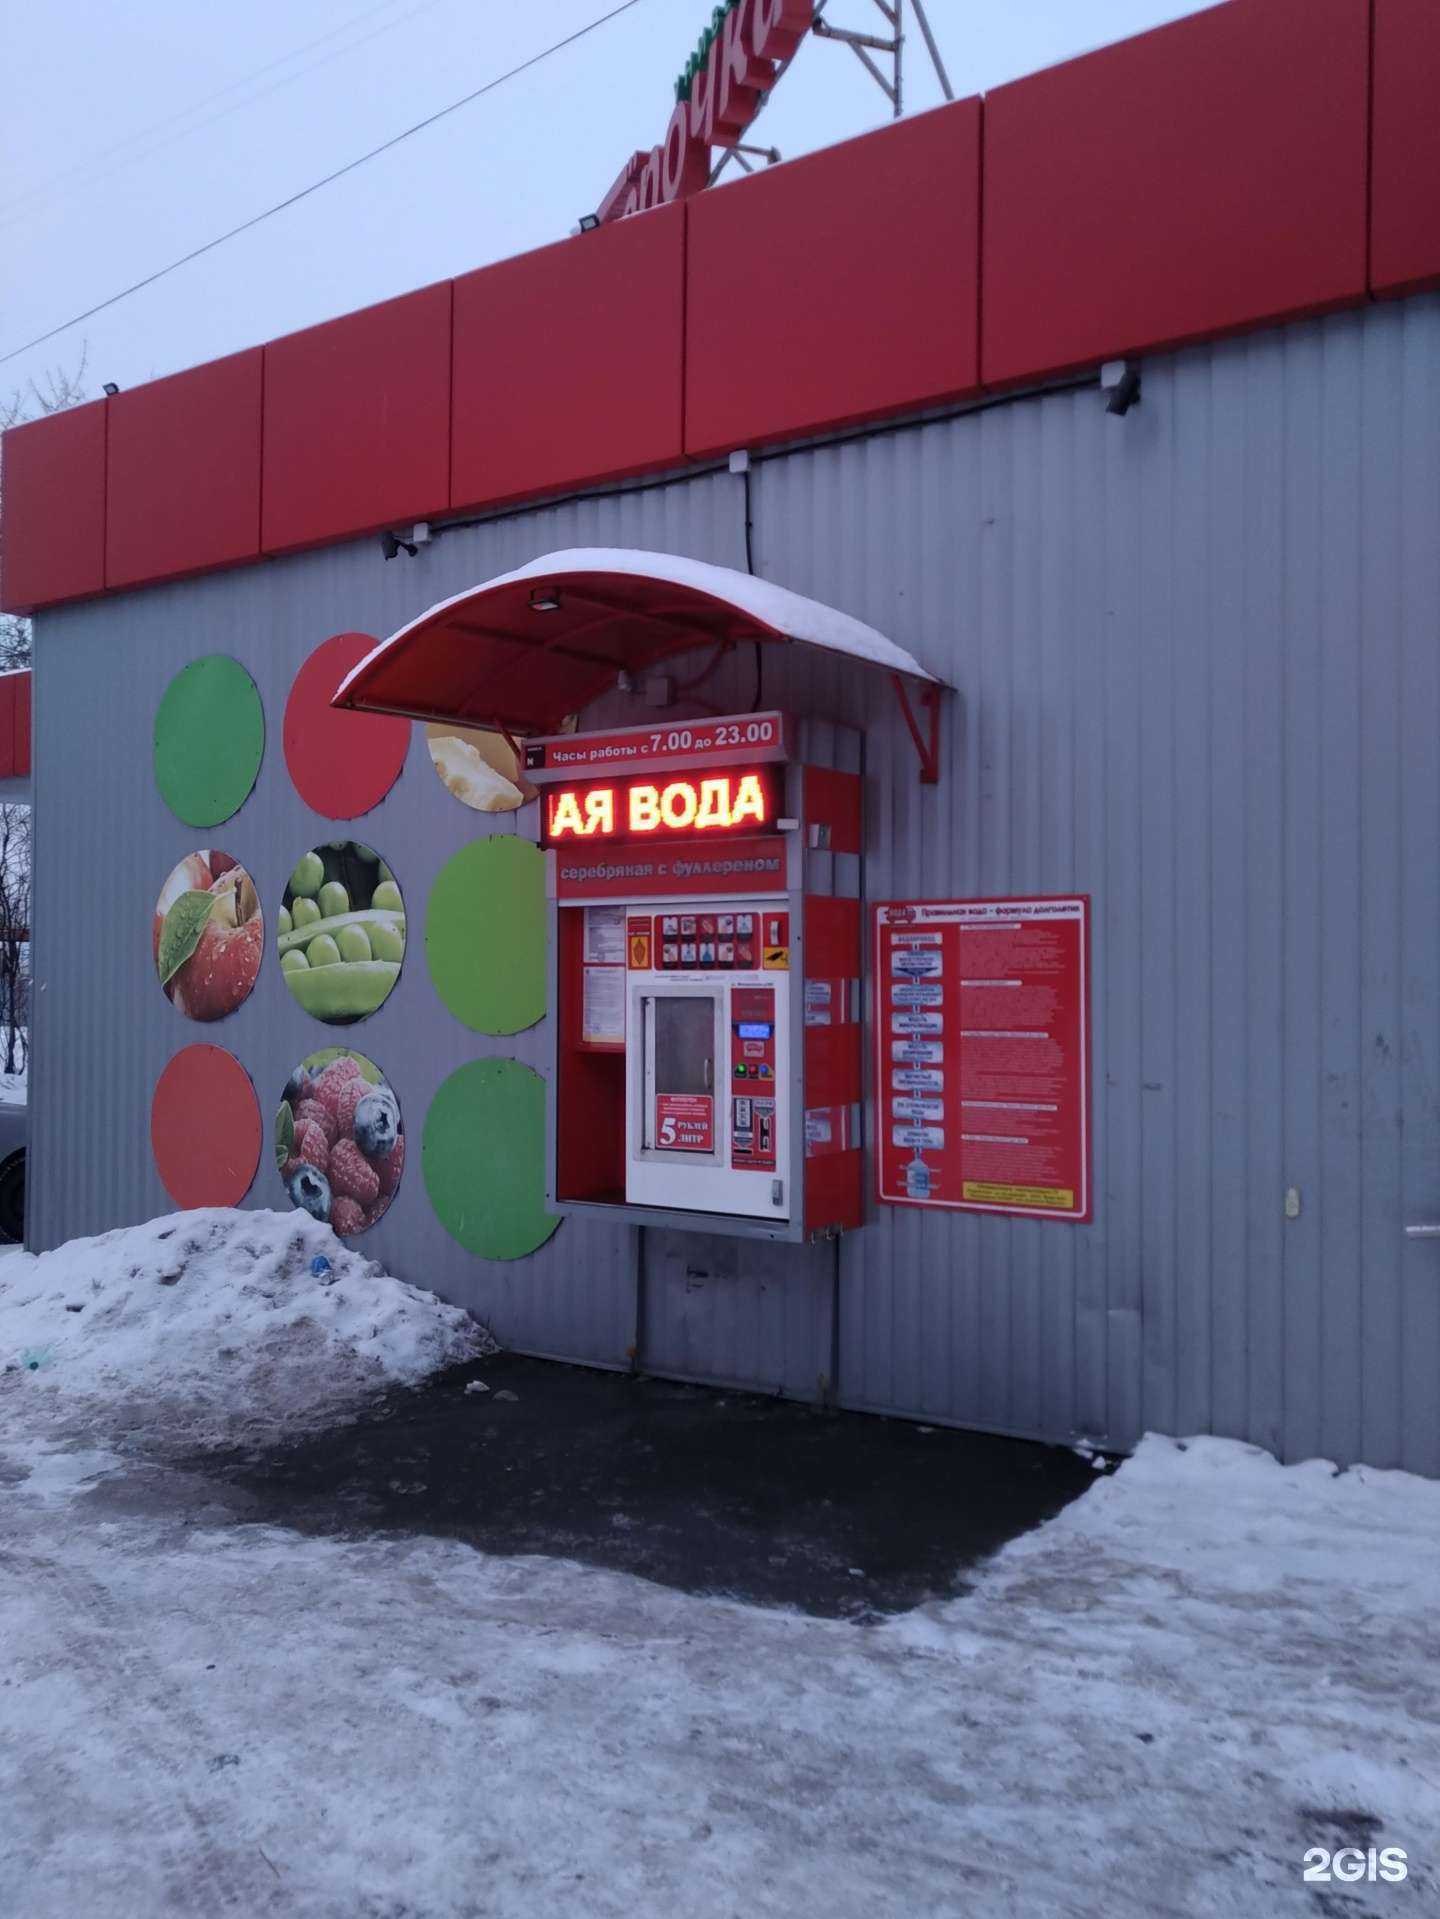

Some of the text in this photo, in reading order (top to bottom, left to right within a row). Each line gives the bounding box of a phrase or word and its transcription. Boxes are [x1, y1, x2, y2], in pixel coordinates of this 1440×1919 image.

[552, 750, 587, 763] Часы
[590, 744, 637, 761] работы
[650, 731, 692, 752] 7.00
[694, 737, 711, 750] до
[715, 722, 773, 746] 23.00
[549, 775, 765, 838] АЯ ВОДА
[560, 863, 653, 881] серебряная
[672, 857, 780, 877] фуллереном
[659, 1117, 676, 1145] 5
